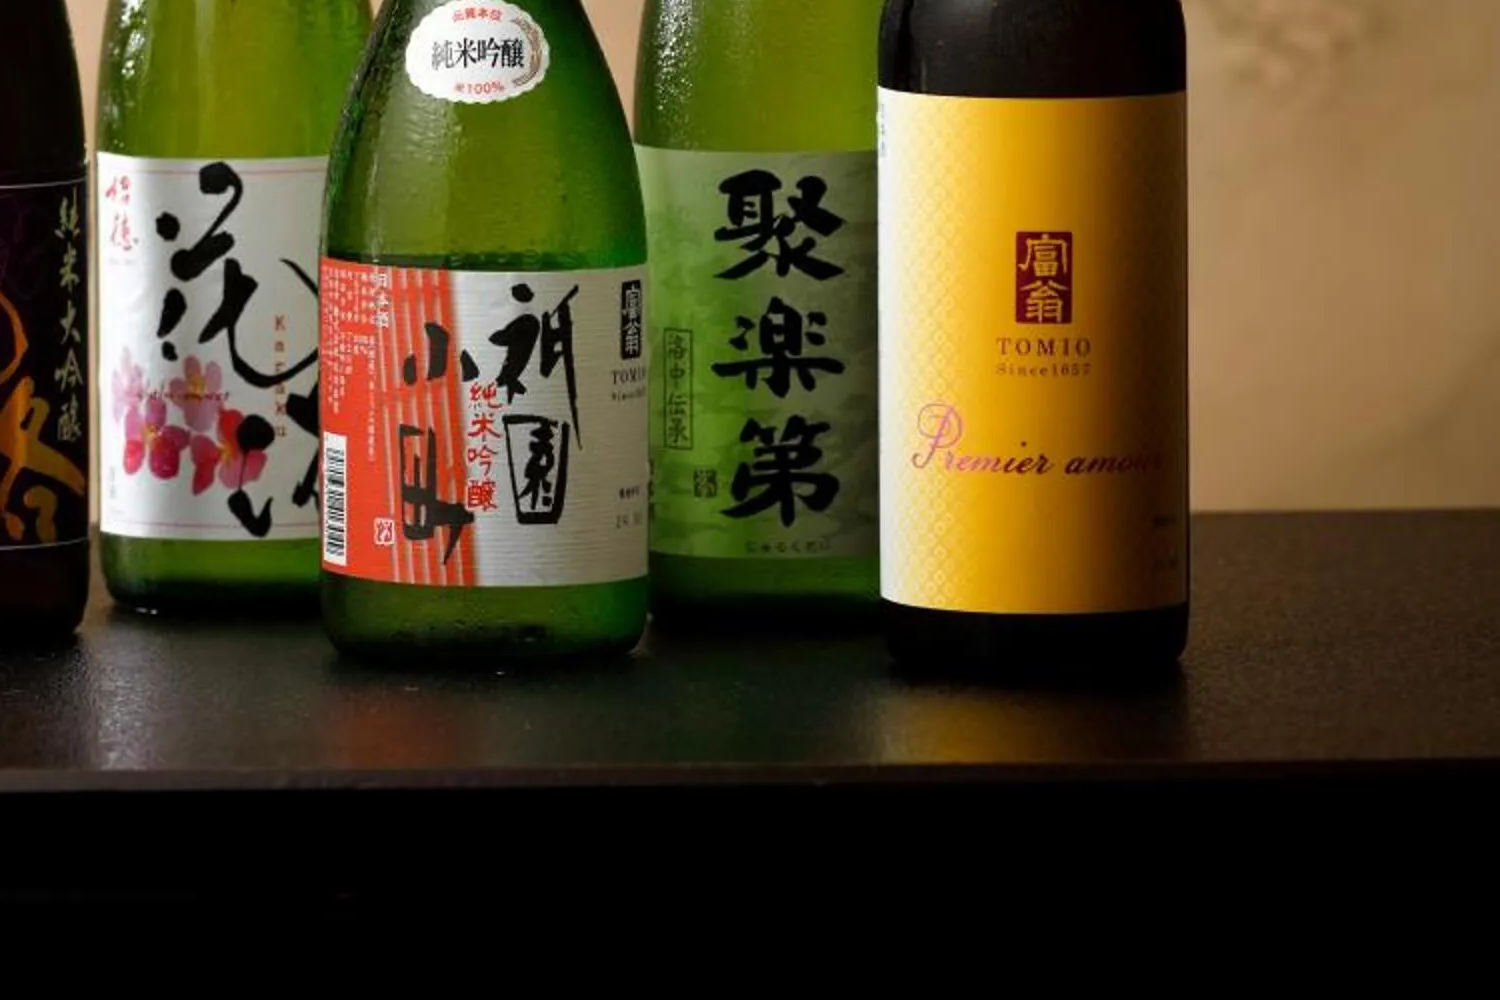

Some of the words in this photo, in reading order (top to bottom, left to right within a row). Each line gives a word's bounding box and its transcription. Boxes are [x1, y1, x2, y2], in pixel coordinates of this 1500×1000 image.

[431, 37, 525, 71] 純米吟醸
[712, 168, 846, 528] 聚楽第
[996, 336, 1092, 357] TOMIO
[467, 381, 502, 512] 純米吟醸
[912, 401, 1055, 475] Premier
